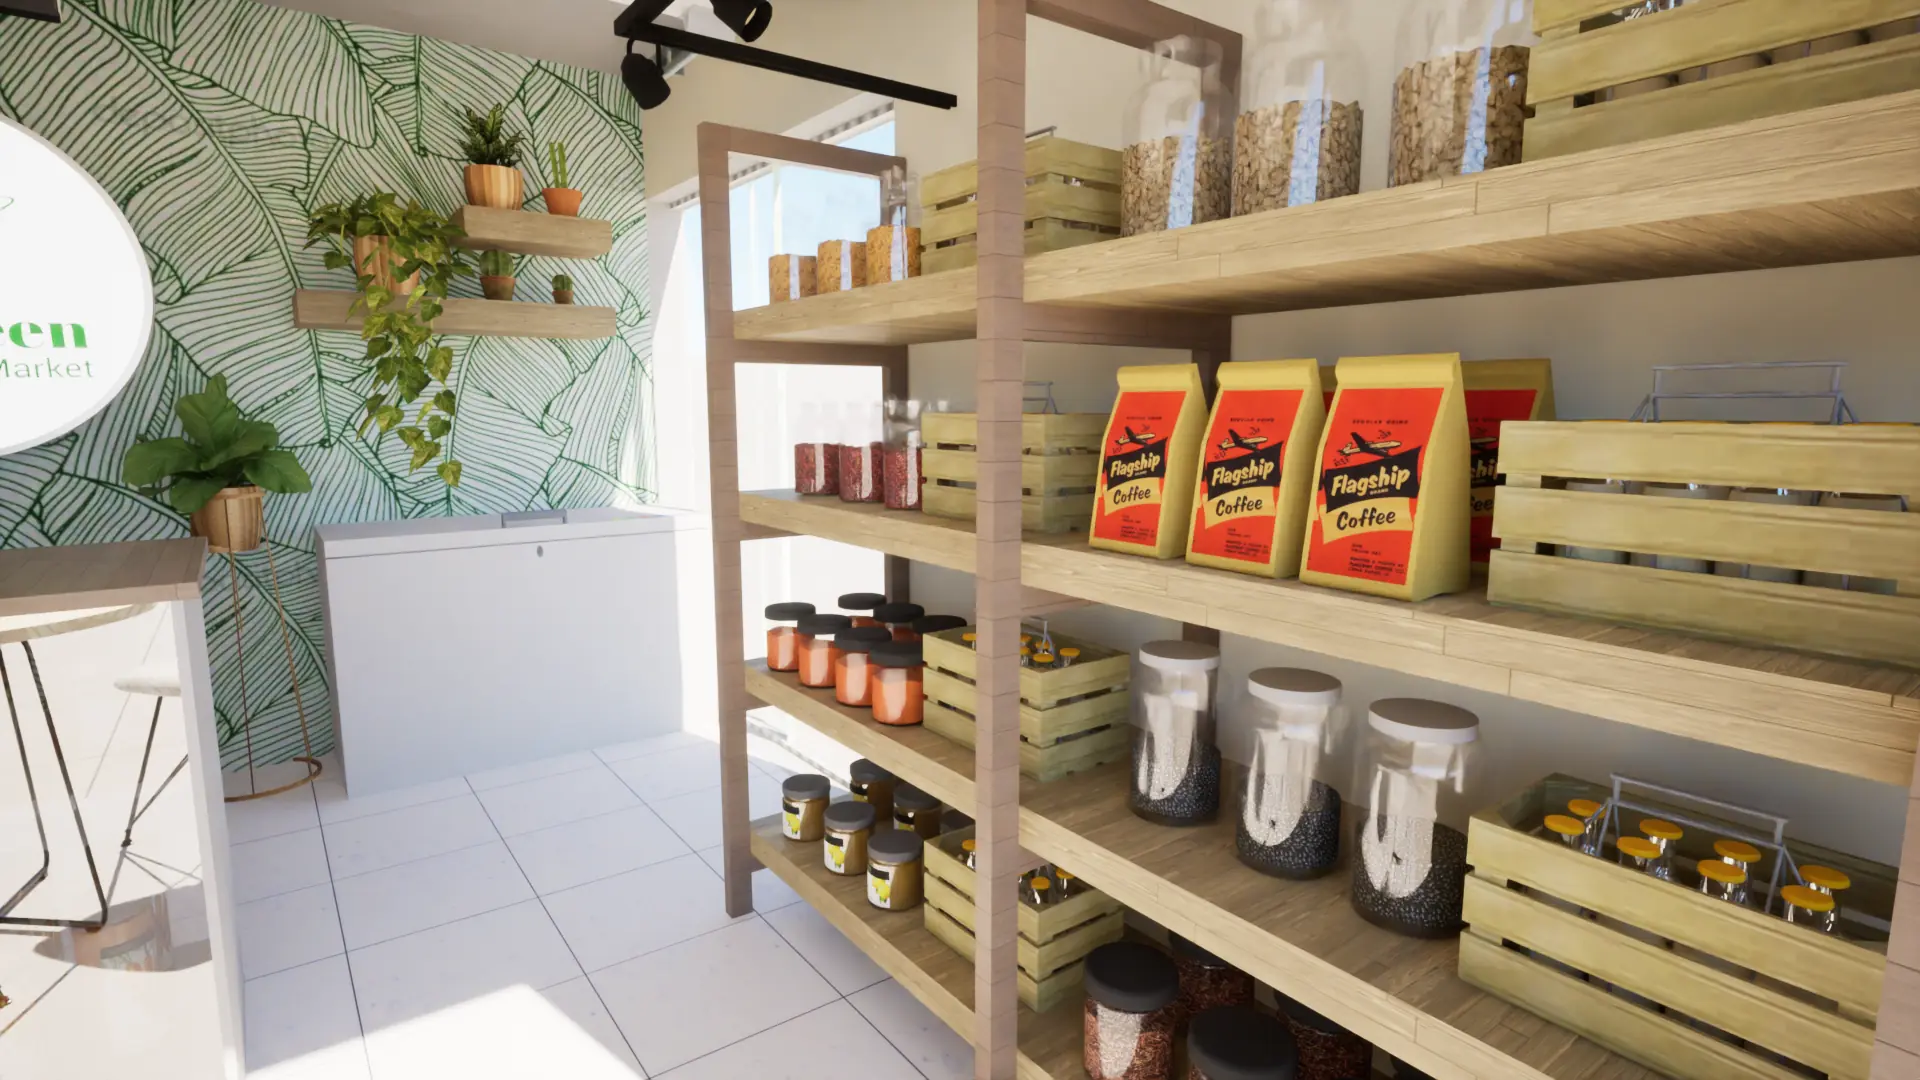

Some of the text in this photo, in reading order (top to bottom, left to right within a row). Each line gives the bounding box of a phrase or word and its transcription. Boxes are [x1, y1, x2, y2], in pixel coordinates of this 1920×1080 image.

[0, 321, 88, 349] en
[1110, 452, 1161, 478] Flagship
[1211, 457, 1274, 487] Flagship
[1331, 465, 1411, 497] Flagship
[1113, 484, 1151, 505] Coffee
[1215, 498, 1263, 517] Coffee
[1336, 507, 1396, 531] Coffee
